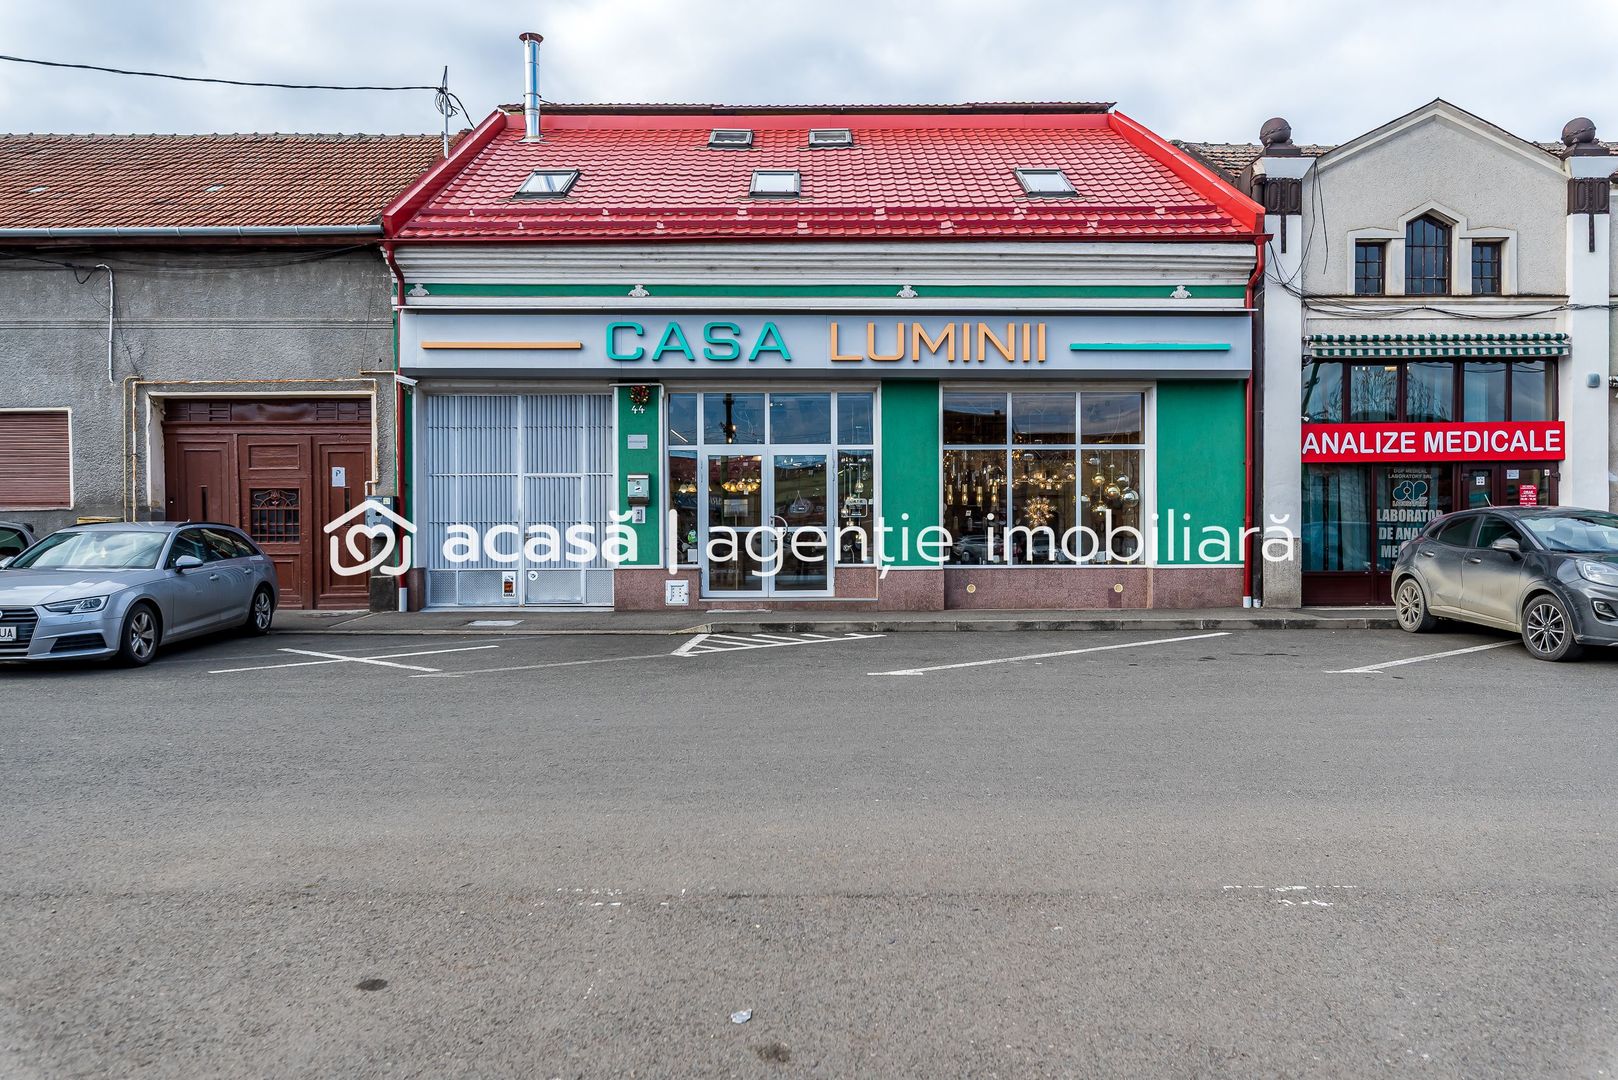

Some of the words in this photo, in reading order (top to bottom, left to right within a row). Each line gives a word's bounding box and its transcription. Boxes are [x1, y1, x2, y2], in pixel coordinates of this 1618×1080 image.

[605, 321, 792, 363] CASA
[830, 322, 1047, 363] LUMINII
[631, 405, 645, 414] 44
[1302, 431, 1416, 455] ANALIZE
[1424, 429, 1562, 453] MEDICALE
[1376, 509, 1444, 522] LABORATOR
[1379, 527, 1394, 540] DE
[1395, 528, 1423, 540] ANA
[1380, 545, 1401, 558] ME
